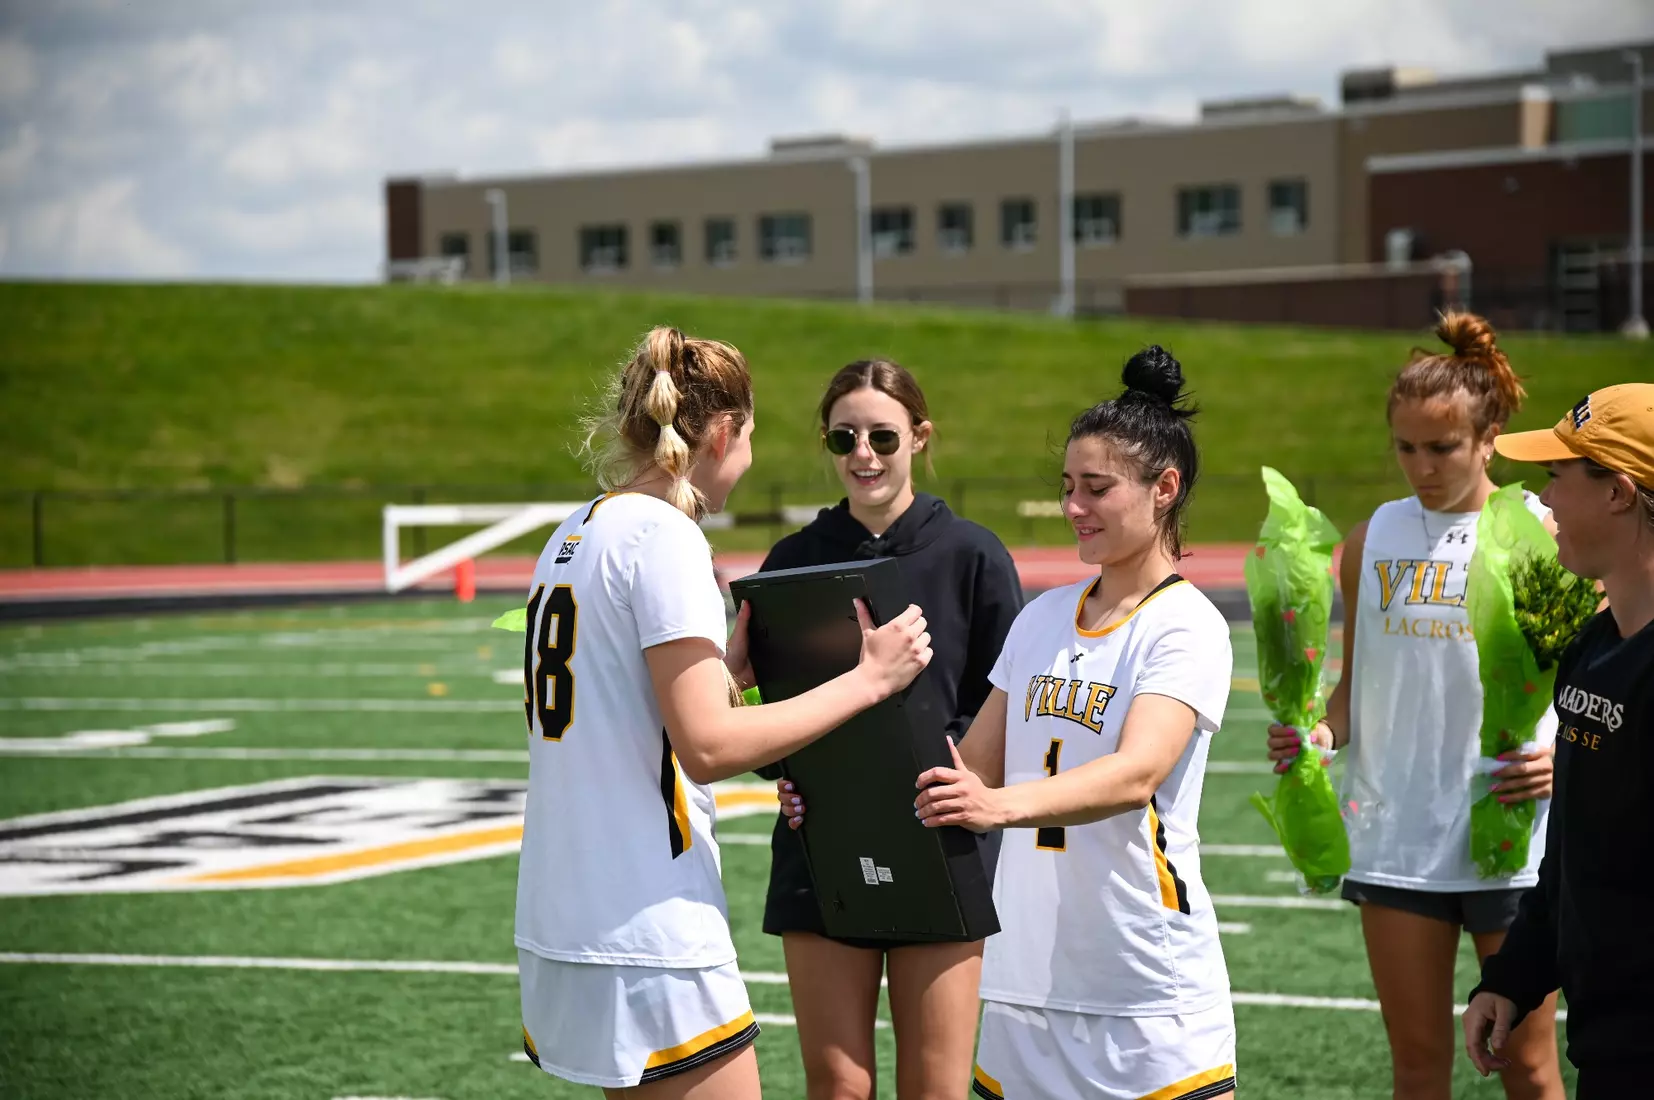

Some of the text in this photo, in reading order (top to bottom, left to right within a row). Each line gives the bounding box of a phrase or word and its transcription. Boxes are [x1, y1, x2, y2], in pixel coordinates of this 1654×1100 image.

[558, 541, 580, 556] PSAC
[1374, 559, 1469, 611] VIL
[1025, 675, 1118, 735] VILLE
